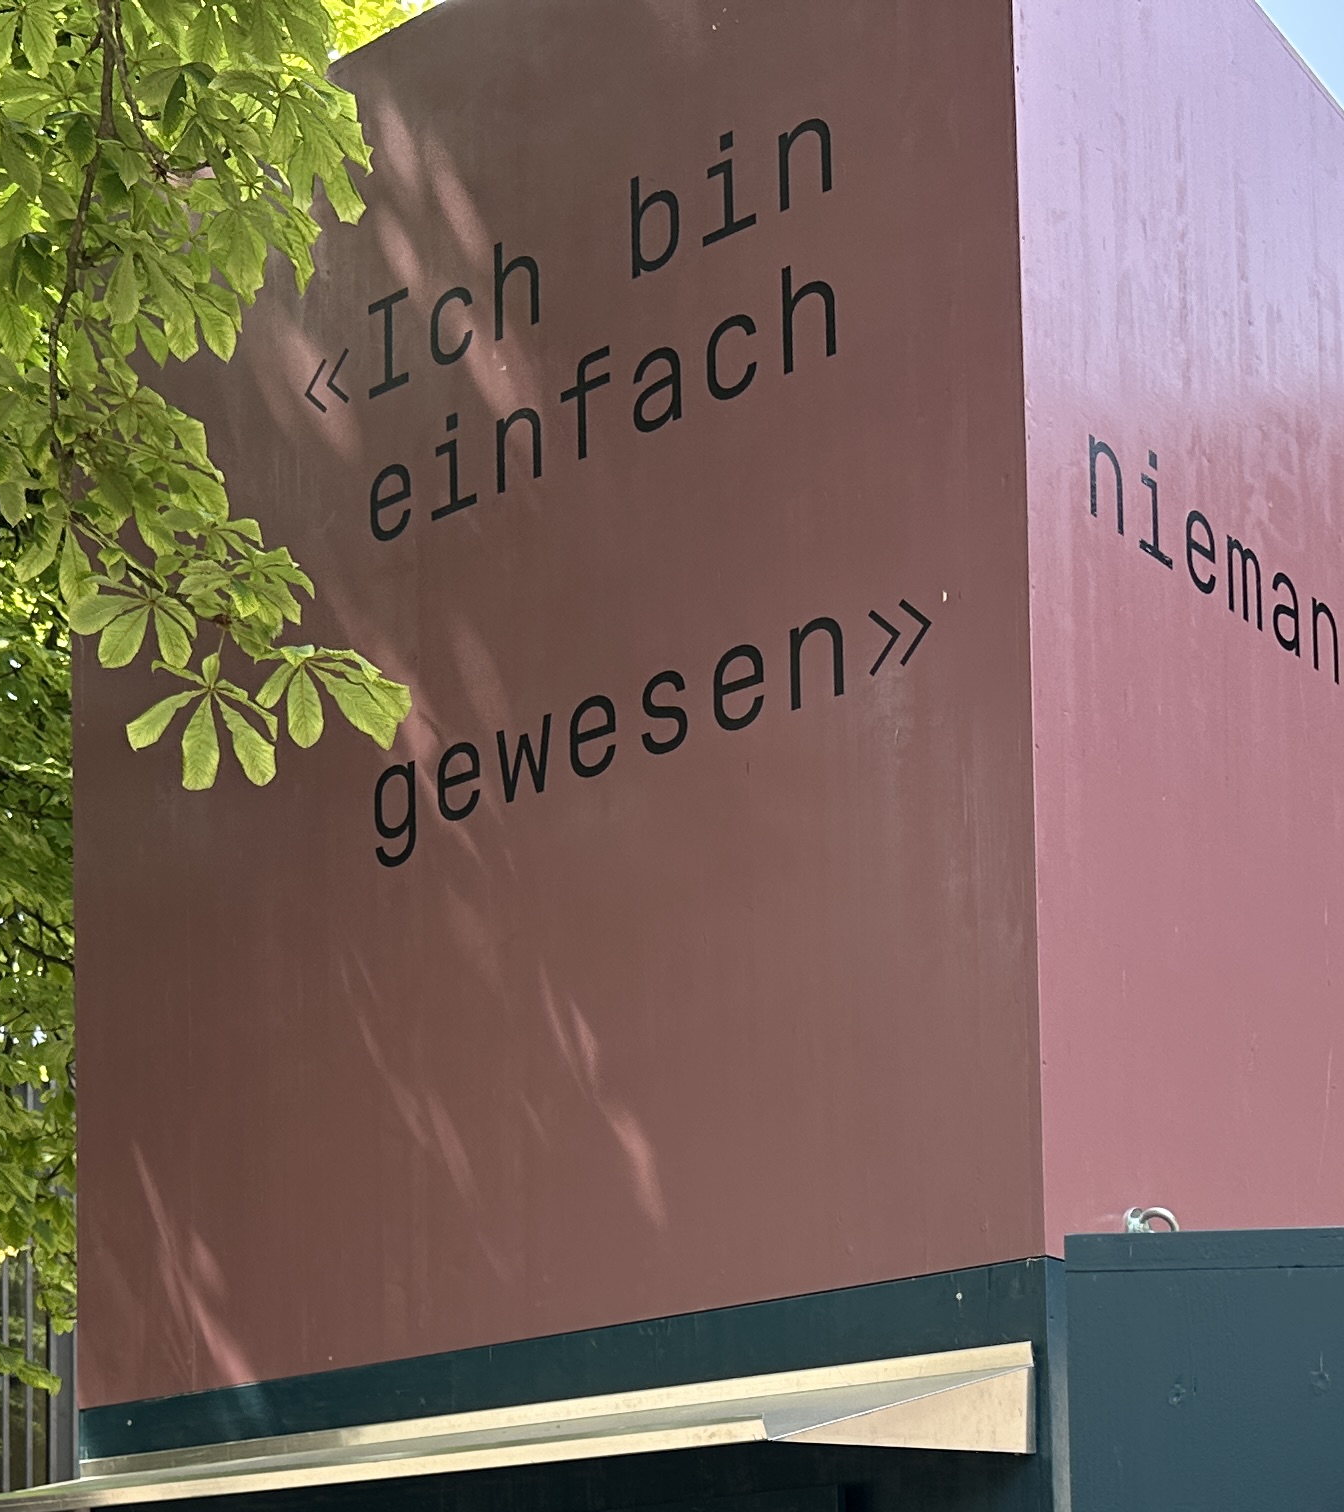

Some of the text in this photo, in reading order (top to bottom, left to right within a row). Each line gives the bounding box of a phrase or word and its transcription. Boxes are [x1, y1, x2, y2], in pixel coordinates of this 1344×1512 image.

[304, 117, 834, 413] «Ich bin
[369, 264, 838, 543] einfach
[373, 598, 932, 867] gewesen»
